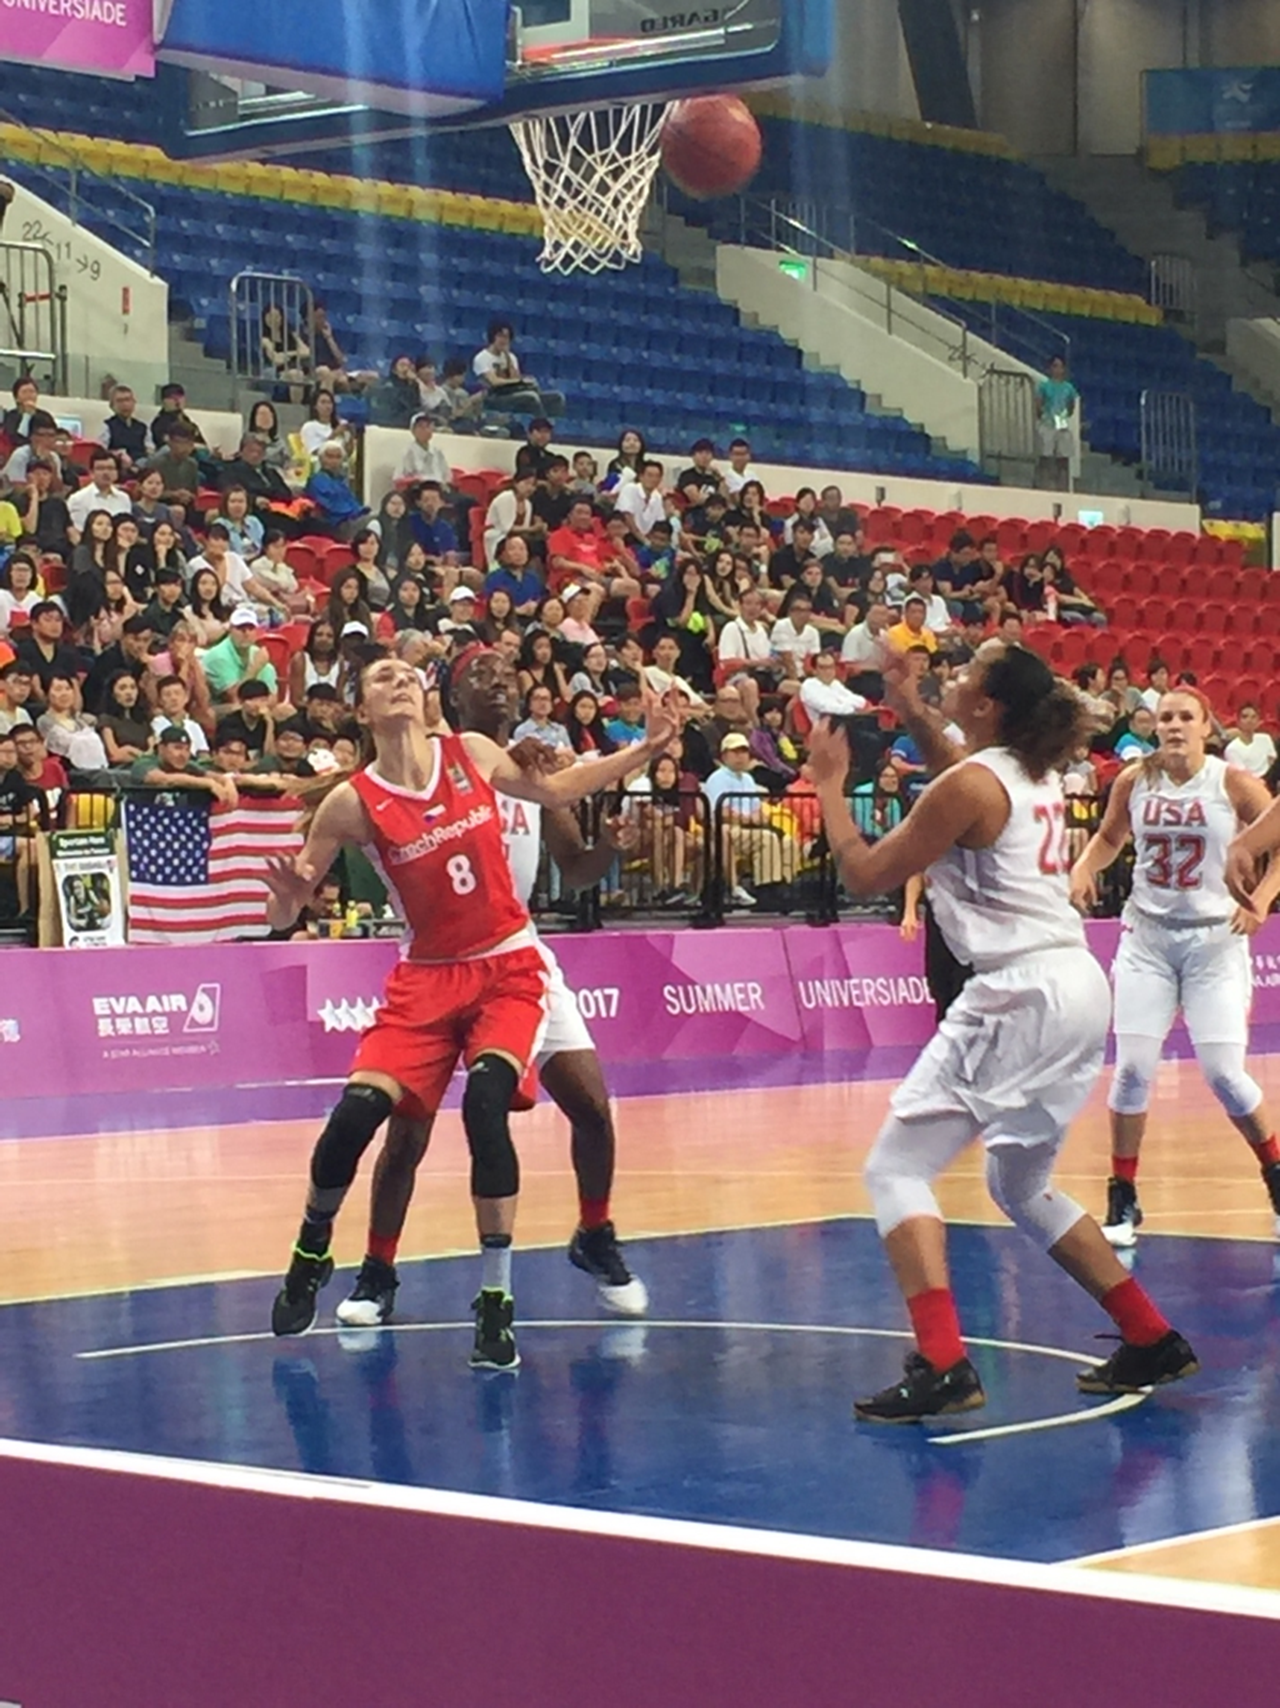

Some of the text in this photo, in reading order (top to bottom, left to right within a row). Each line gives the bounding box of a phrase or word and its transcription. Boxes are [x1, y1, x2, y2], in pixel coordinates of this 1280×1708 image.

[501, 801, 530, 836] SA
[1143, 798, 1207, 827] USA
[446, 854, 477, 895] 8
[1143, 833, 1207, 890] 32
[578, 987, 620, 1019] 017
[663, 981, 765, 1015] SUMMER
